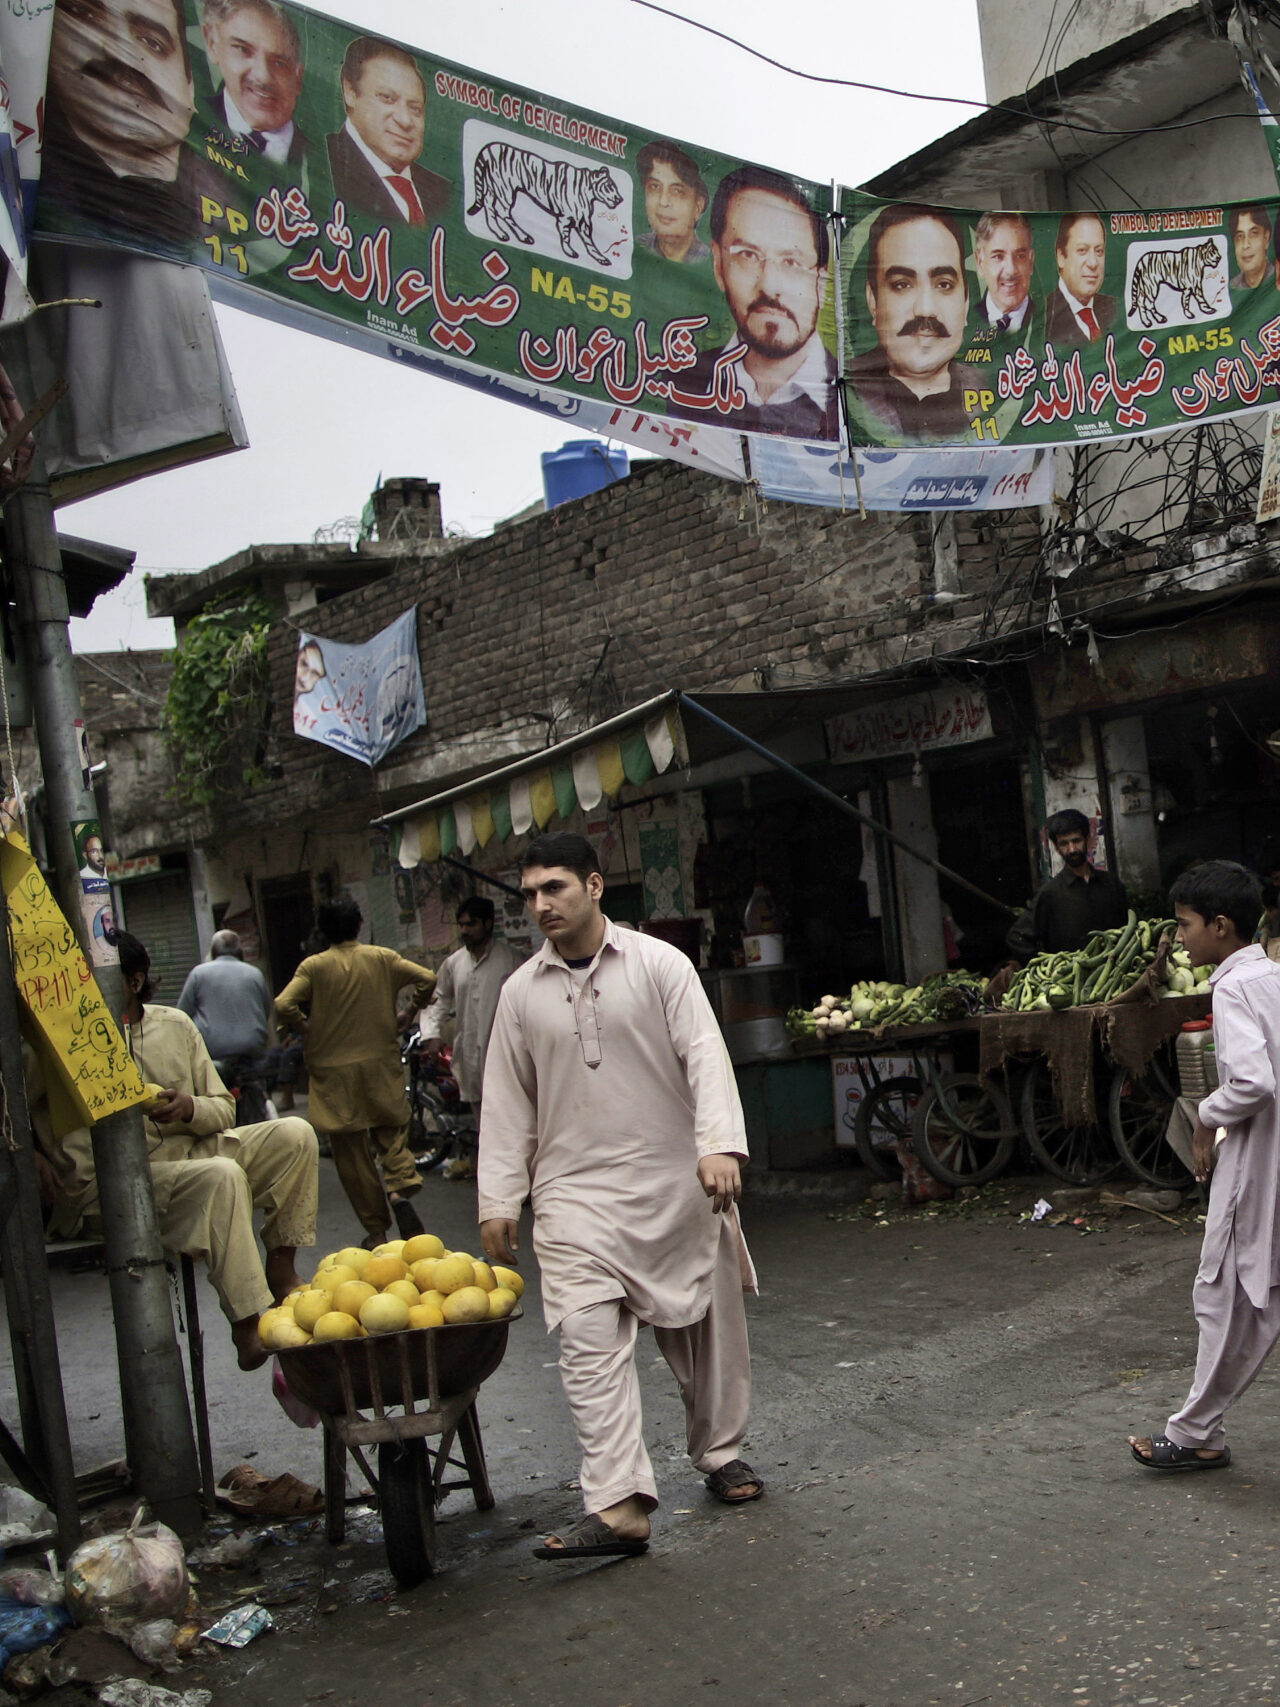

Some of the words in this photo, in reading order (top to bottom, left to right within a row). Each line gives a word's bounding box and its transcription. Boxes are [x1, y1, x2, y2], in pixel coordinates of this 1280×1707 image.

[435, 70, 500, 115] SYMBOL
[500, 94, 521, 121] OF
[524, 103, 628, 159] DEVELOPMENT
[205, 145, 250, 182] MPA
[200, 194, 249, 236] PP
[253, 185, 319, 247] شاہ
[1110, 212, 1149, 234] SYMBOL
[1150, 213, 1162, 231] OF
[1162, 207, 1224, 230] DEVELOPMENT
[203, 233, 249, 275] 11
[287, 200, 392, 306] اللہ
[394, 224, 521, 357] ضیاء
[531, 267, 633, 319] NA-55
[366, 310, 398, 330] Inam
[401, 323, 418, 338] Ad
[1167, 326, 1235, 356] NA-55
[520, 326, 627, 386] اعوان
[602, 314, 710, 405] شکیل
[667, 343, 749, 415] ملک
[964, 348, 993, 363] MPA
[998, 345, 1038, 400] شاہ
[1087, 334, 1166, 429] ضیاء
[962, 389, 995, 413] PP
[1021, 341, 1086, 427] اللہ
[970, 416, 999, 441] 11
[1074, 423, 1099, 432] Inam
[1099, 420, 1110, 430] Ad
